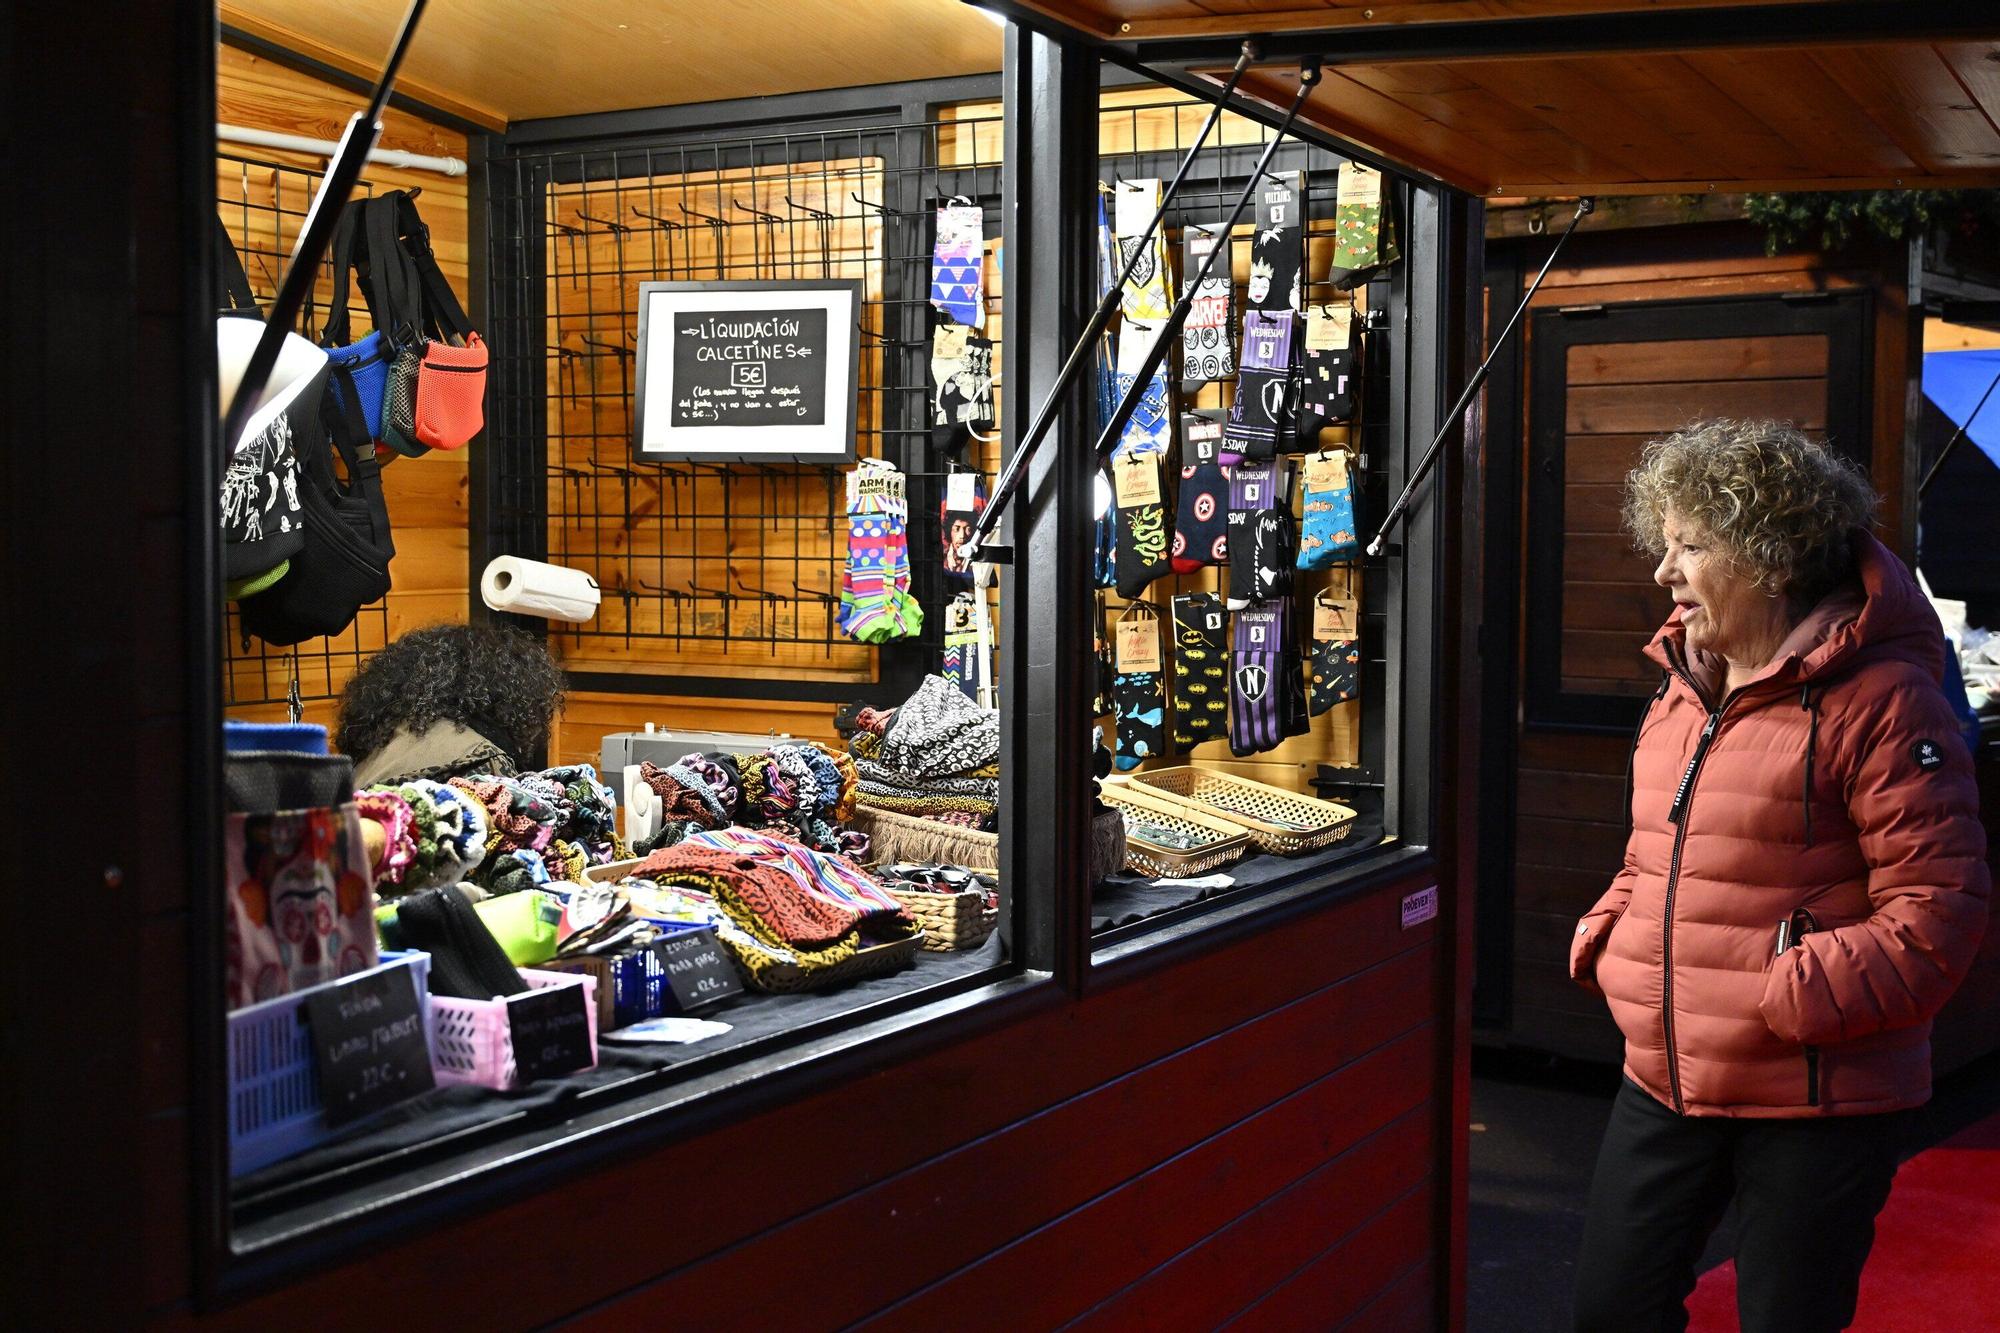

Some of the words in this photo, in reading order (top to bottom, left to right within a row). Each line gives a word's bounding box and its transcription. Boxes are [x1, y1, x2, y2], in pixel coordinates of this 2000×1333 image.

[700, 317, 800, 339] LIQUIDACIÓN
[1250, 327, 1285, 338] WEDNESDAY
[696, 340, 797, 361] CALCETINES
[739, 367, 762, 384] 5€
[1236, 470, 1270, 480] WEDNESDAY
[858, 478, 885, 488] ARM
[858, 487, 885, 495] WARMERS
[956, 607, 969, 627] 3
[1241, 612, 1275, 622] WEDNESDAY
[1246, 668, 1259, 695] N
